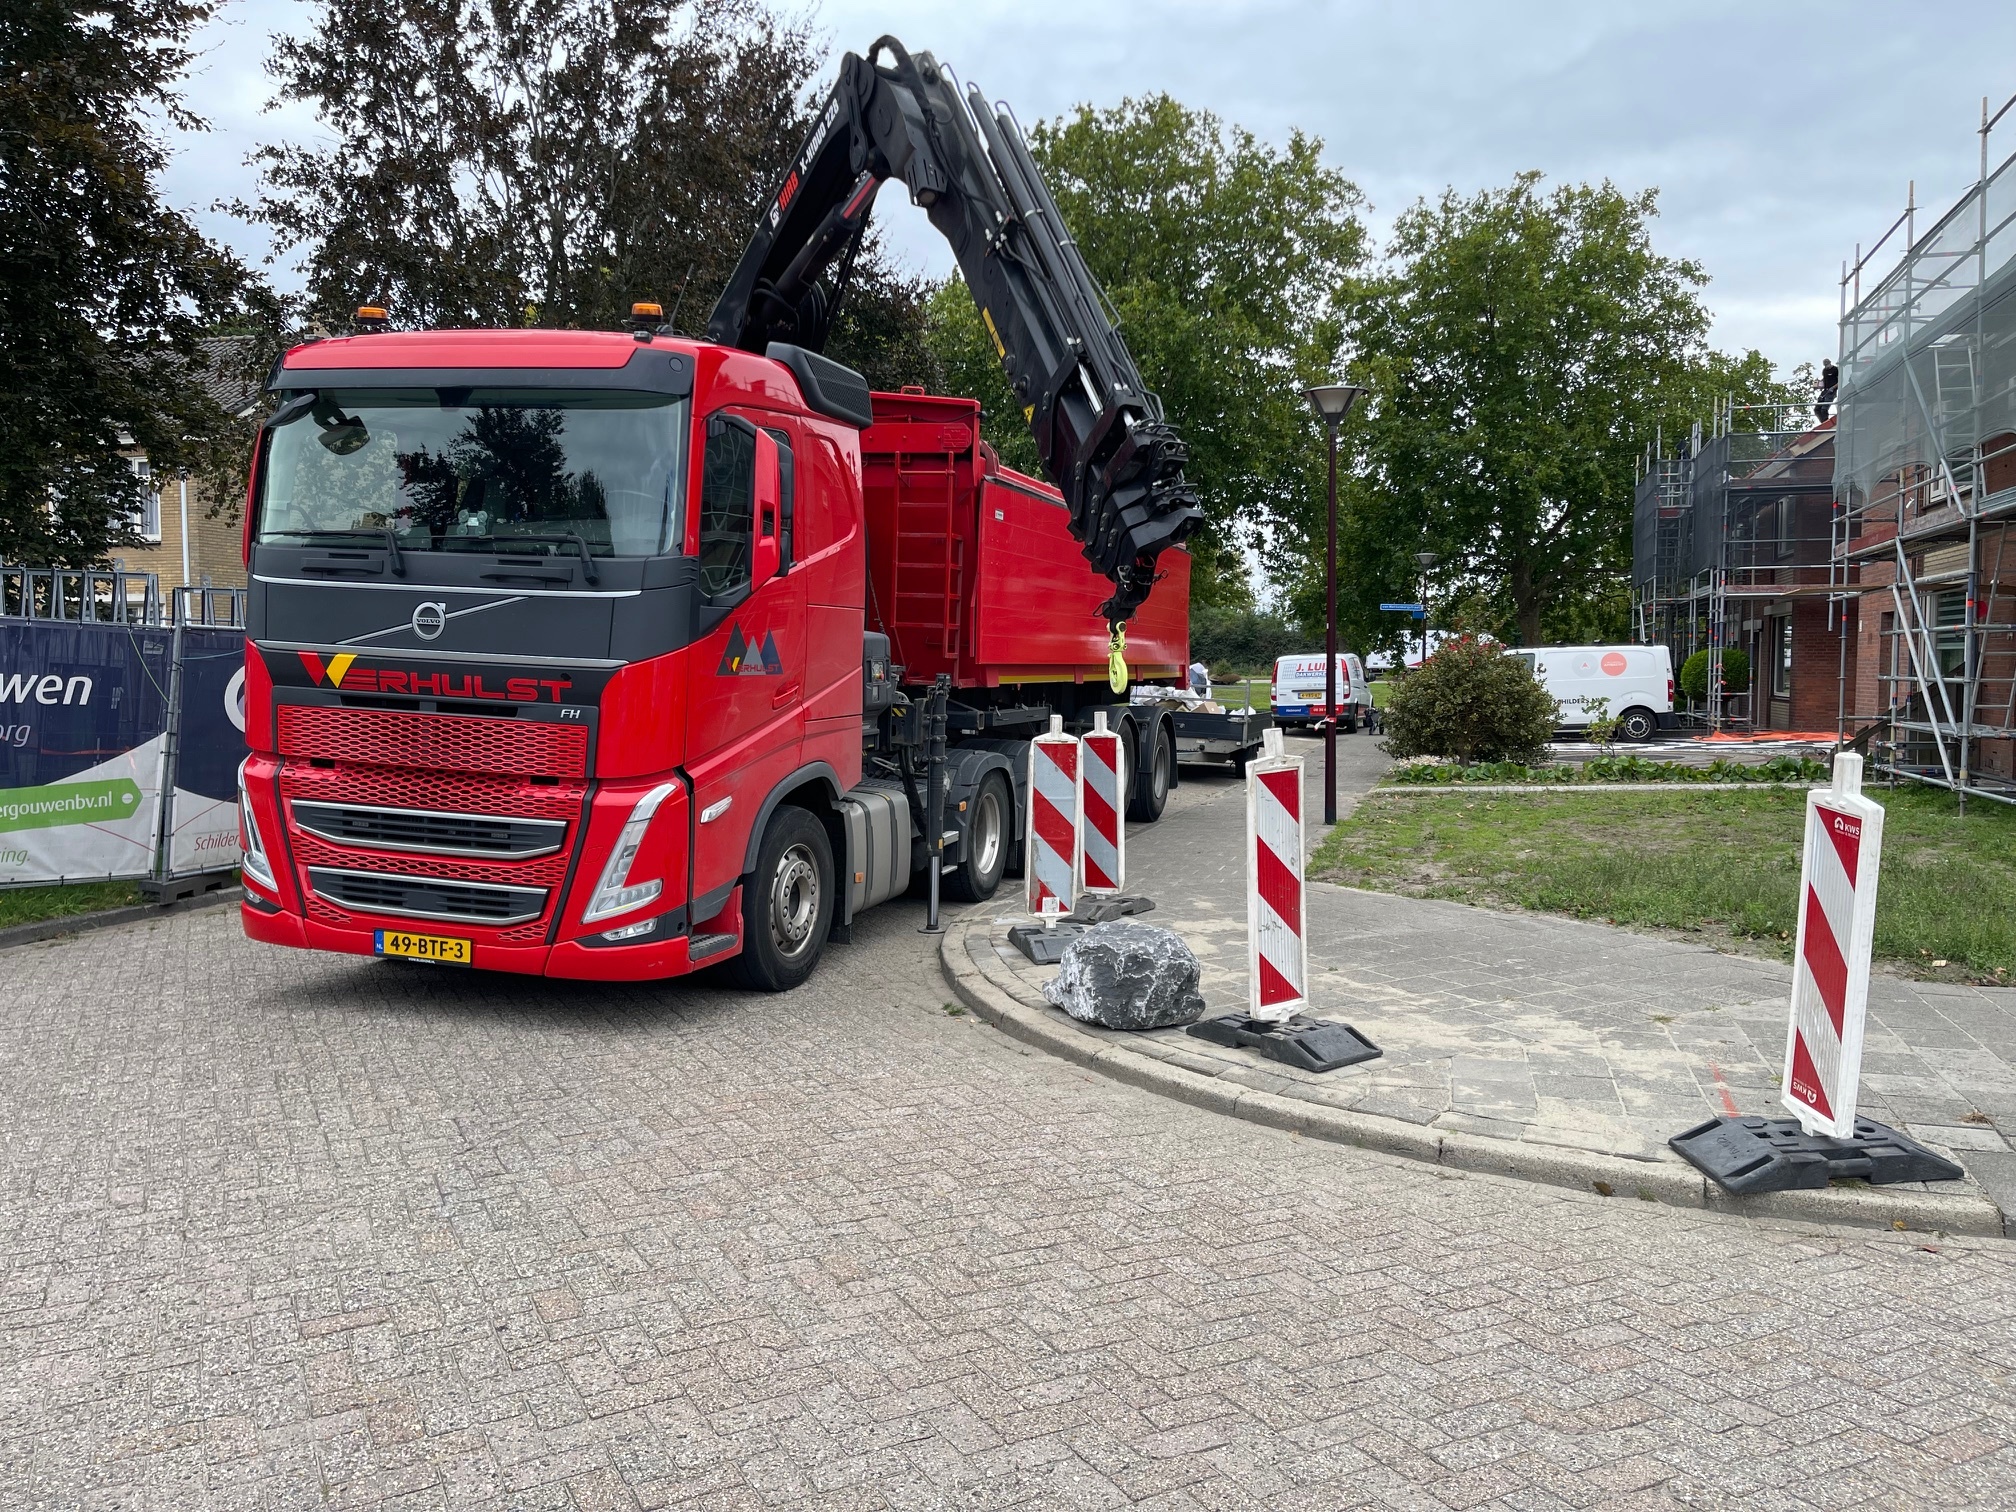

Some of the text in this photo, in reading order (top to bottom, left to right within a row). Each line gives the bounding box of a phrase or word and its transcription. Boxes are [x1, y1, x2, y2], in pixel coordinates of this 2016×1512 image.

[779, 170, 799, 212] HIAB
[799, 121, 827, 175] X-HIDUO
[725, 656, 780, 673] VERHULST
[1296, 663, 1305, 672] J.
[297, 650, 573, 703] VERHULST
[560, 708, 581, 719] FH
[0, 790, 113, 820] rgouwenbv.nl
[1844, 823, 1860, 836] KWS
[0, 847, 31, 867] ing.
[390, 934, 464, 959] 49-BTF-3
[1792, 1081, 1808, 1096] KWS
